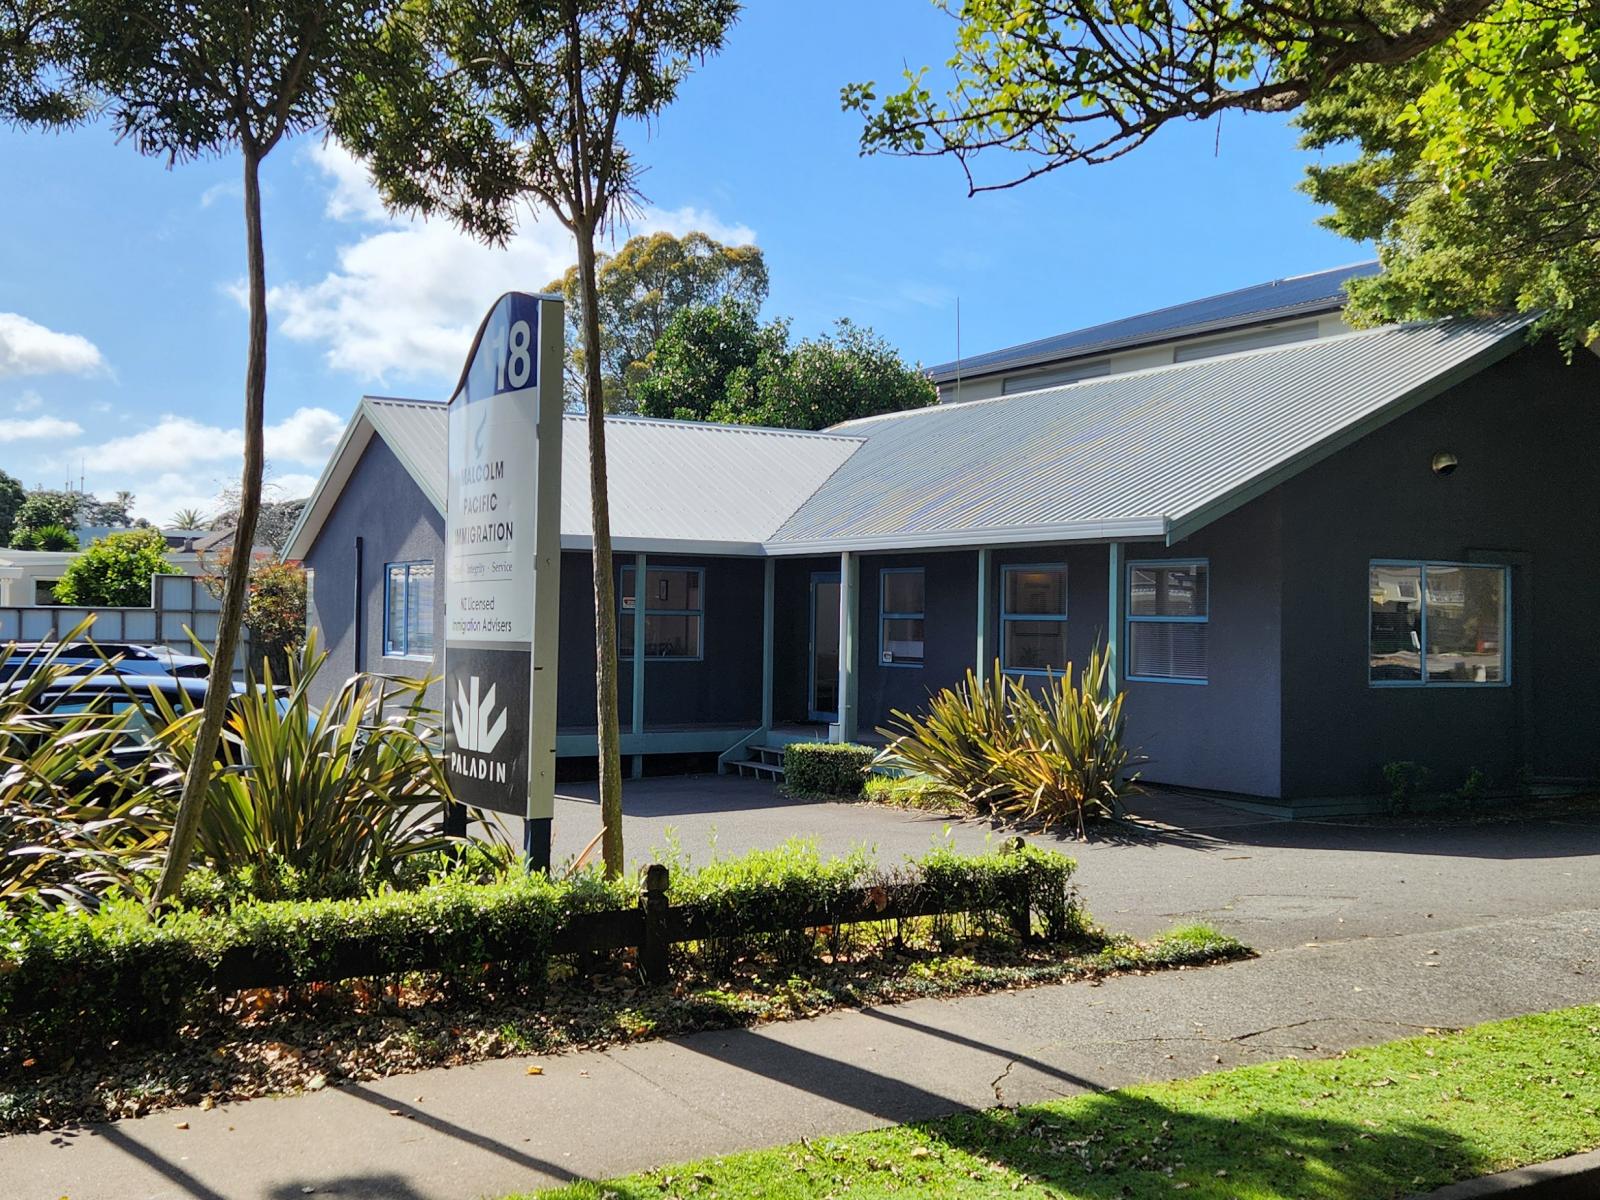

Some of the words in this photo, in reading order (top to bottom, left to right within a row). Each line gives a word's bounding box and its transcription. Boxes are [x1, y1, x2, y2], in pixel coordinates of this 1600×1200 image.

[492, 320, 531, 390] 18
[463, 493, 498, 515] PACIFIC
[454, 521, 513, 545] MMIGRATION
[492, 561, 512, 573] Service
[482, 618, 512, 633] Advisers
[451, 752, 506, 784] PALADIN
